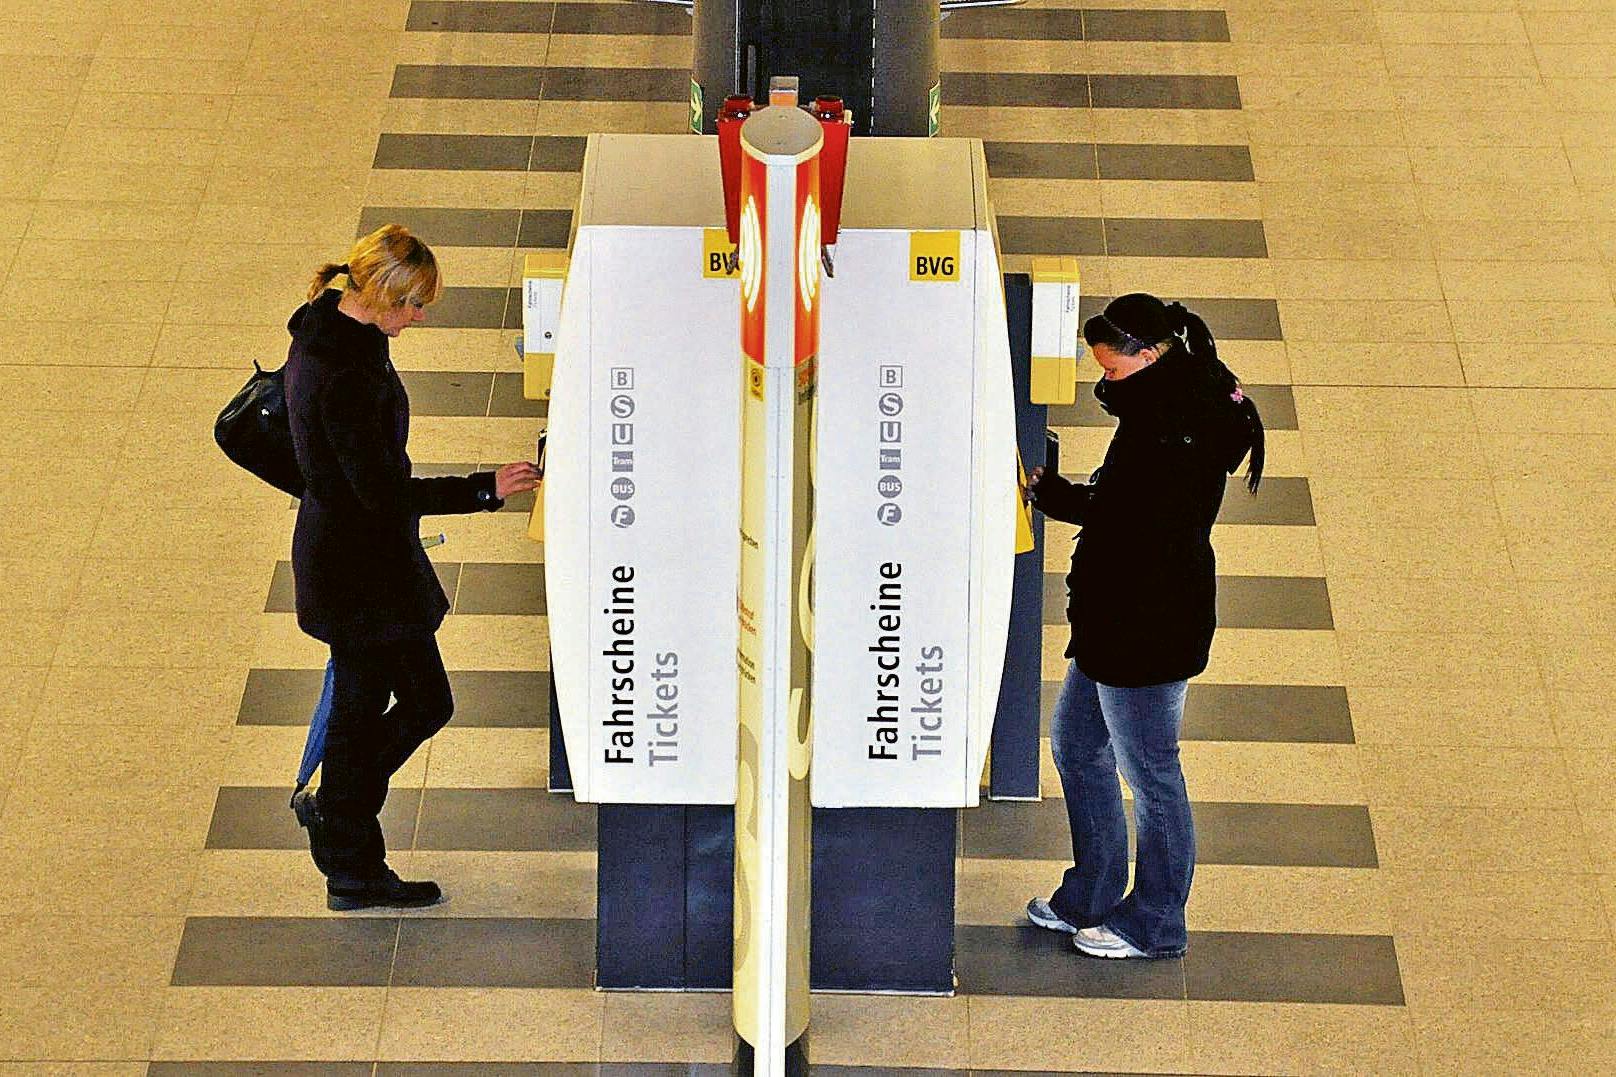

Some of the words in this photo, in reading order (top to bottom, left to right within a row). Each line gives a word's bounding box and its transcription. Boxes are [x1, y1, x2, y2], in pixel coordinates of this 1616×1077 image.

[916, 256, 954, 276] BVG
[612, 396, 633, 417] S
[881, 394, 901, 415] S
[614, 424, 632, 444] U
[882, 422, 899, 441] U
[612, 483, 634, 494] BUS
[879, 481, 901, 492] BUS
[602, 565, 635, 764] Fahrscheine
[866, 561, 902, 760] Fahrscheine
[647, 651, 678, 767] Tickets
[911, 646, 943, 761] Tickets
